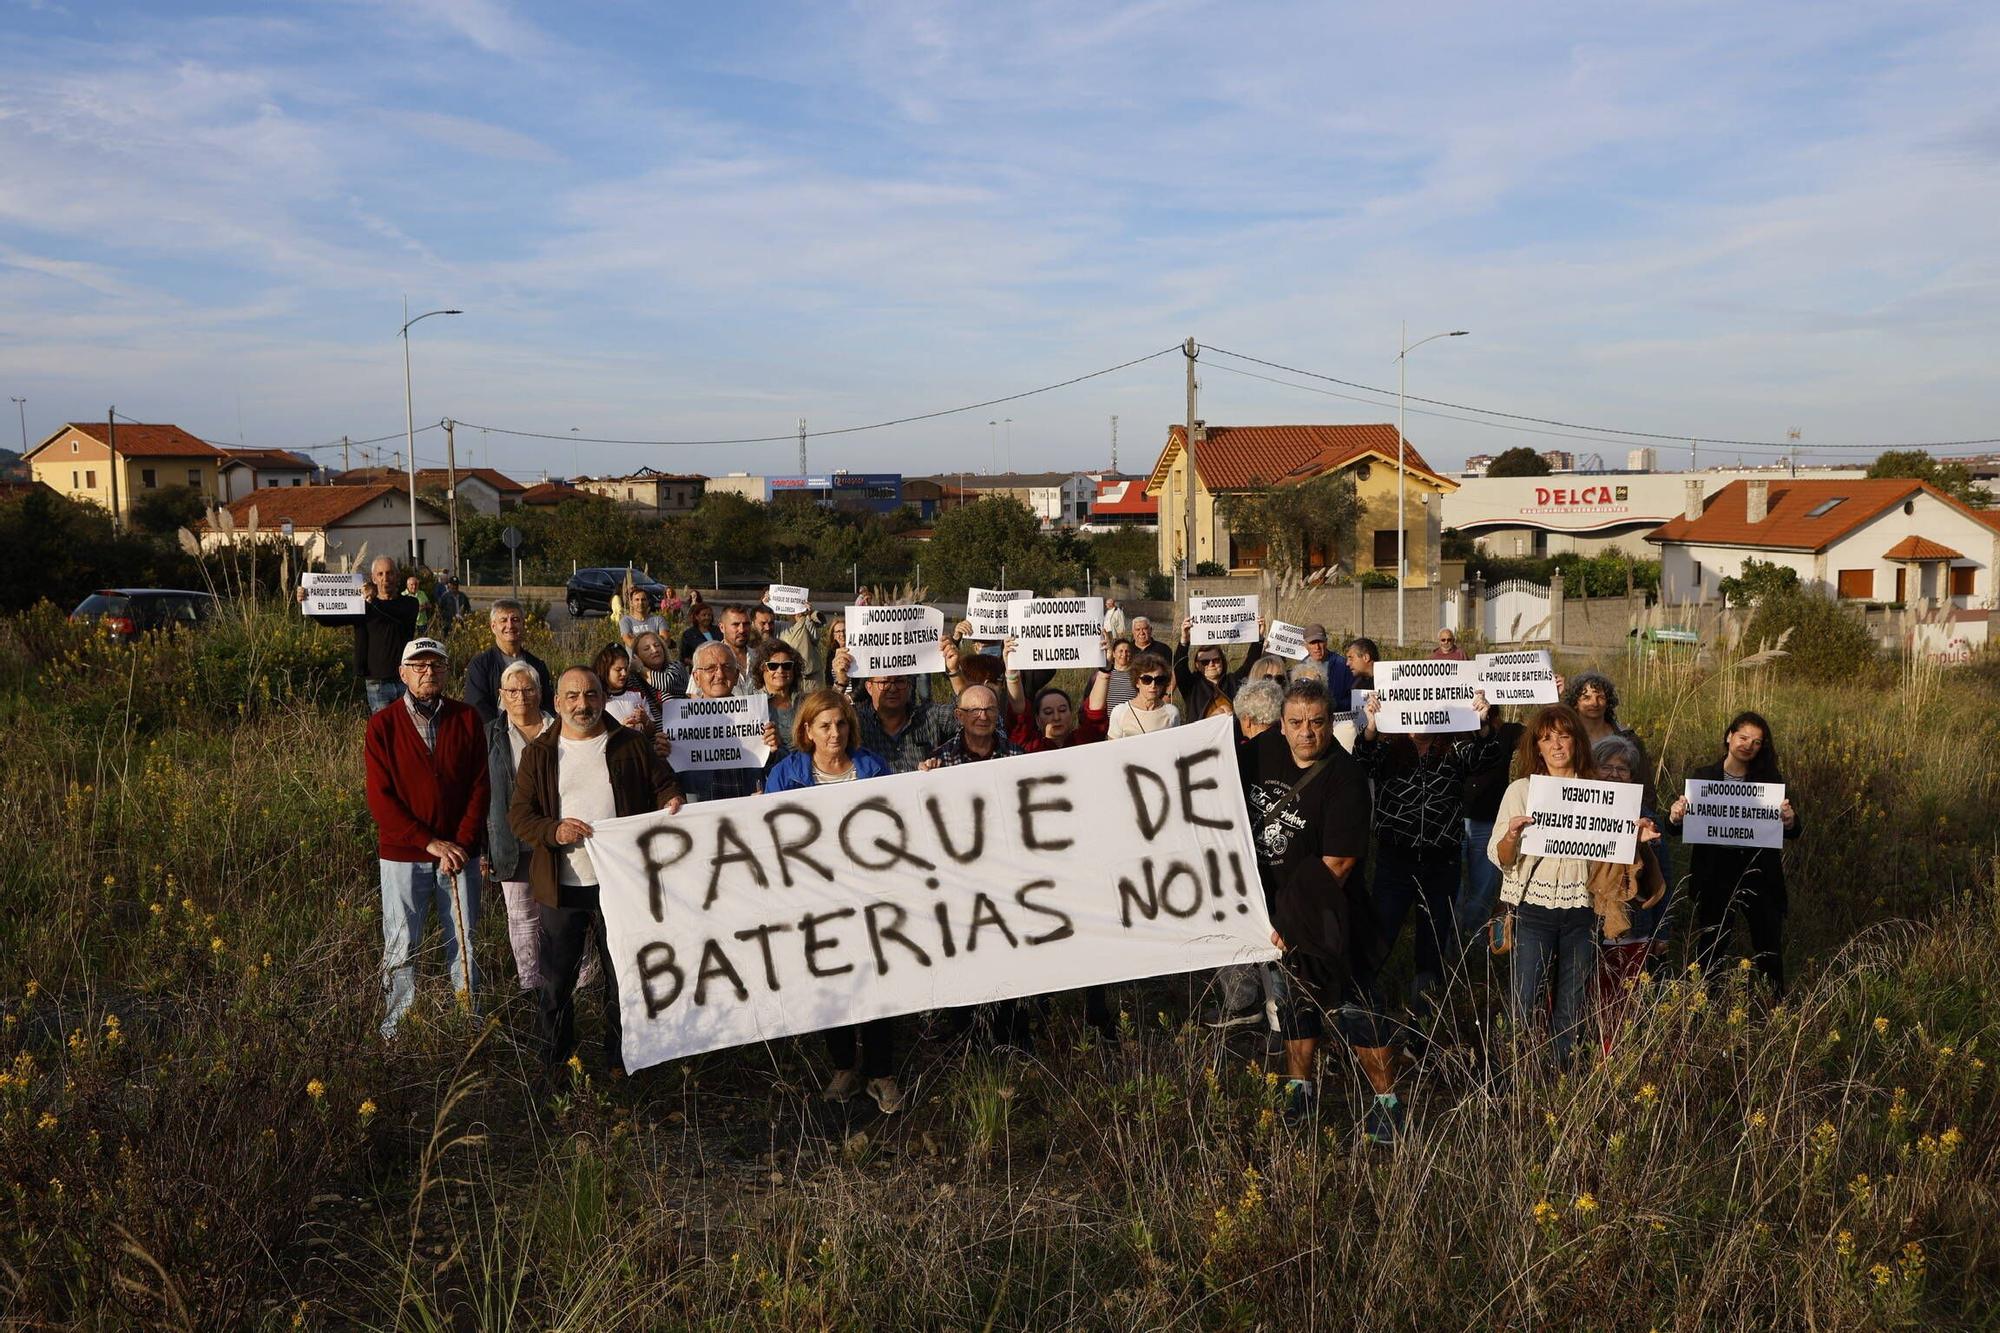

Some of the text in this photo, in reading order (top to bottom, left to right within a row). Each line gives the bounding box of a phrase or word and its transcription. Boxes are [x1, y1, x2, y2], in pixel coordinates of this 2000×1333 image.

[1535, 486, 1613, 505] DELCA
[311, 588, 330, 597] PARQUE
[331, 588, 337, 596] DE
[318, 602, 348, 610] EN LLOREDA
[973, 608, 994, 618] PARQUE
[995, 610, 1002, 618] DE
[1199, 615, 1220, 624] PARQUE
[1222, 614, 1229, 623] DE
[980, 625, 988, 634] EN
[1011, 626, 1019, 638] AL
[1021, 625, 1051, 639] PARQUE
[1053, 624, 1064, 638] DE
[1208, 629, 1241, 639] EN LLOREDA
[848, 633, 857, 647] AL
[858, 633, 890, 646] PARQUE
[891, 632, 903, 646] DE
[870, 654, 917, 669] EN LLOREDA
[1033, 648, 1080, 661] EN LLOREDA
[1486, 672, 1511, 682] PARQUE
[1512, 671, 1520, 682] DE
[1377, 689, 1387, 701] AL
[1389, 688, 1421, 701] PARQUE
[1423, 688, 1433, 700] DE
[1496, 689, 1535, 699] EN LLOREDA
[1401, 711, 1451, 725] EN LLOREDA
[666, 729, 675, 741] AL
[678, 727, 711, 741] PARQUE
[712, 726, 724, 739] DE
[691, 748, 741, 763] EN LLOREDA
[1562, 786, 1615, 805] EN LLOREDA
[1686, 803, 1695, 815] AL
[1697, 803, 1728, 818] PARQUE
[1729, 806, 1740, 818] DE
[1575, 815, 1587, 830] DE
[1589, 817, 1623, 833] PARQUE
[1626, 820, 1636, 835] AL
[636, 747, 1234, 923] PARQUE DE
[1708, 826, 1754, 840] EN LLOREDA
[1118, 848, 1248, 928] NO!!
